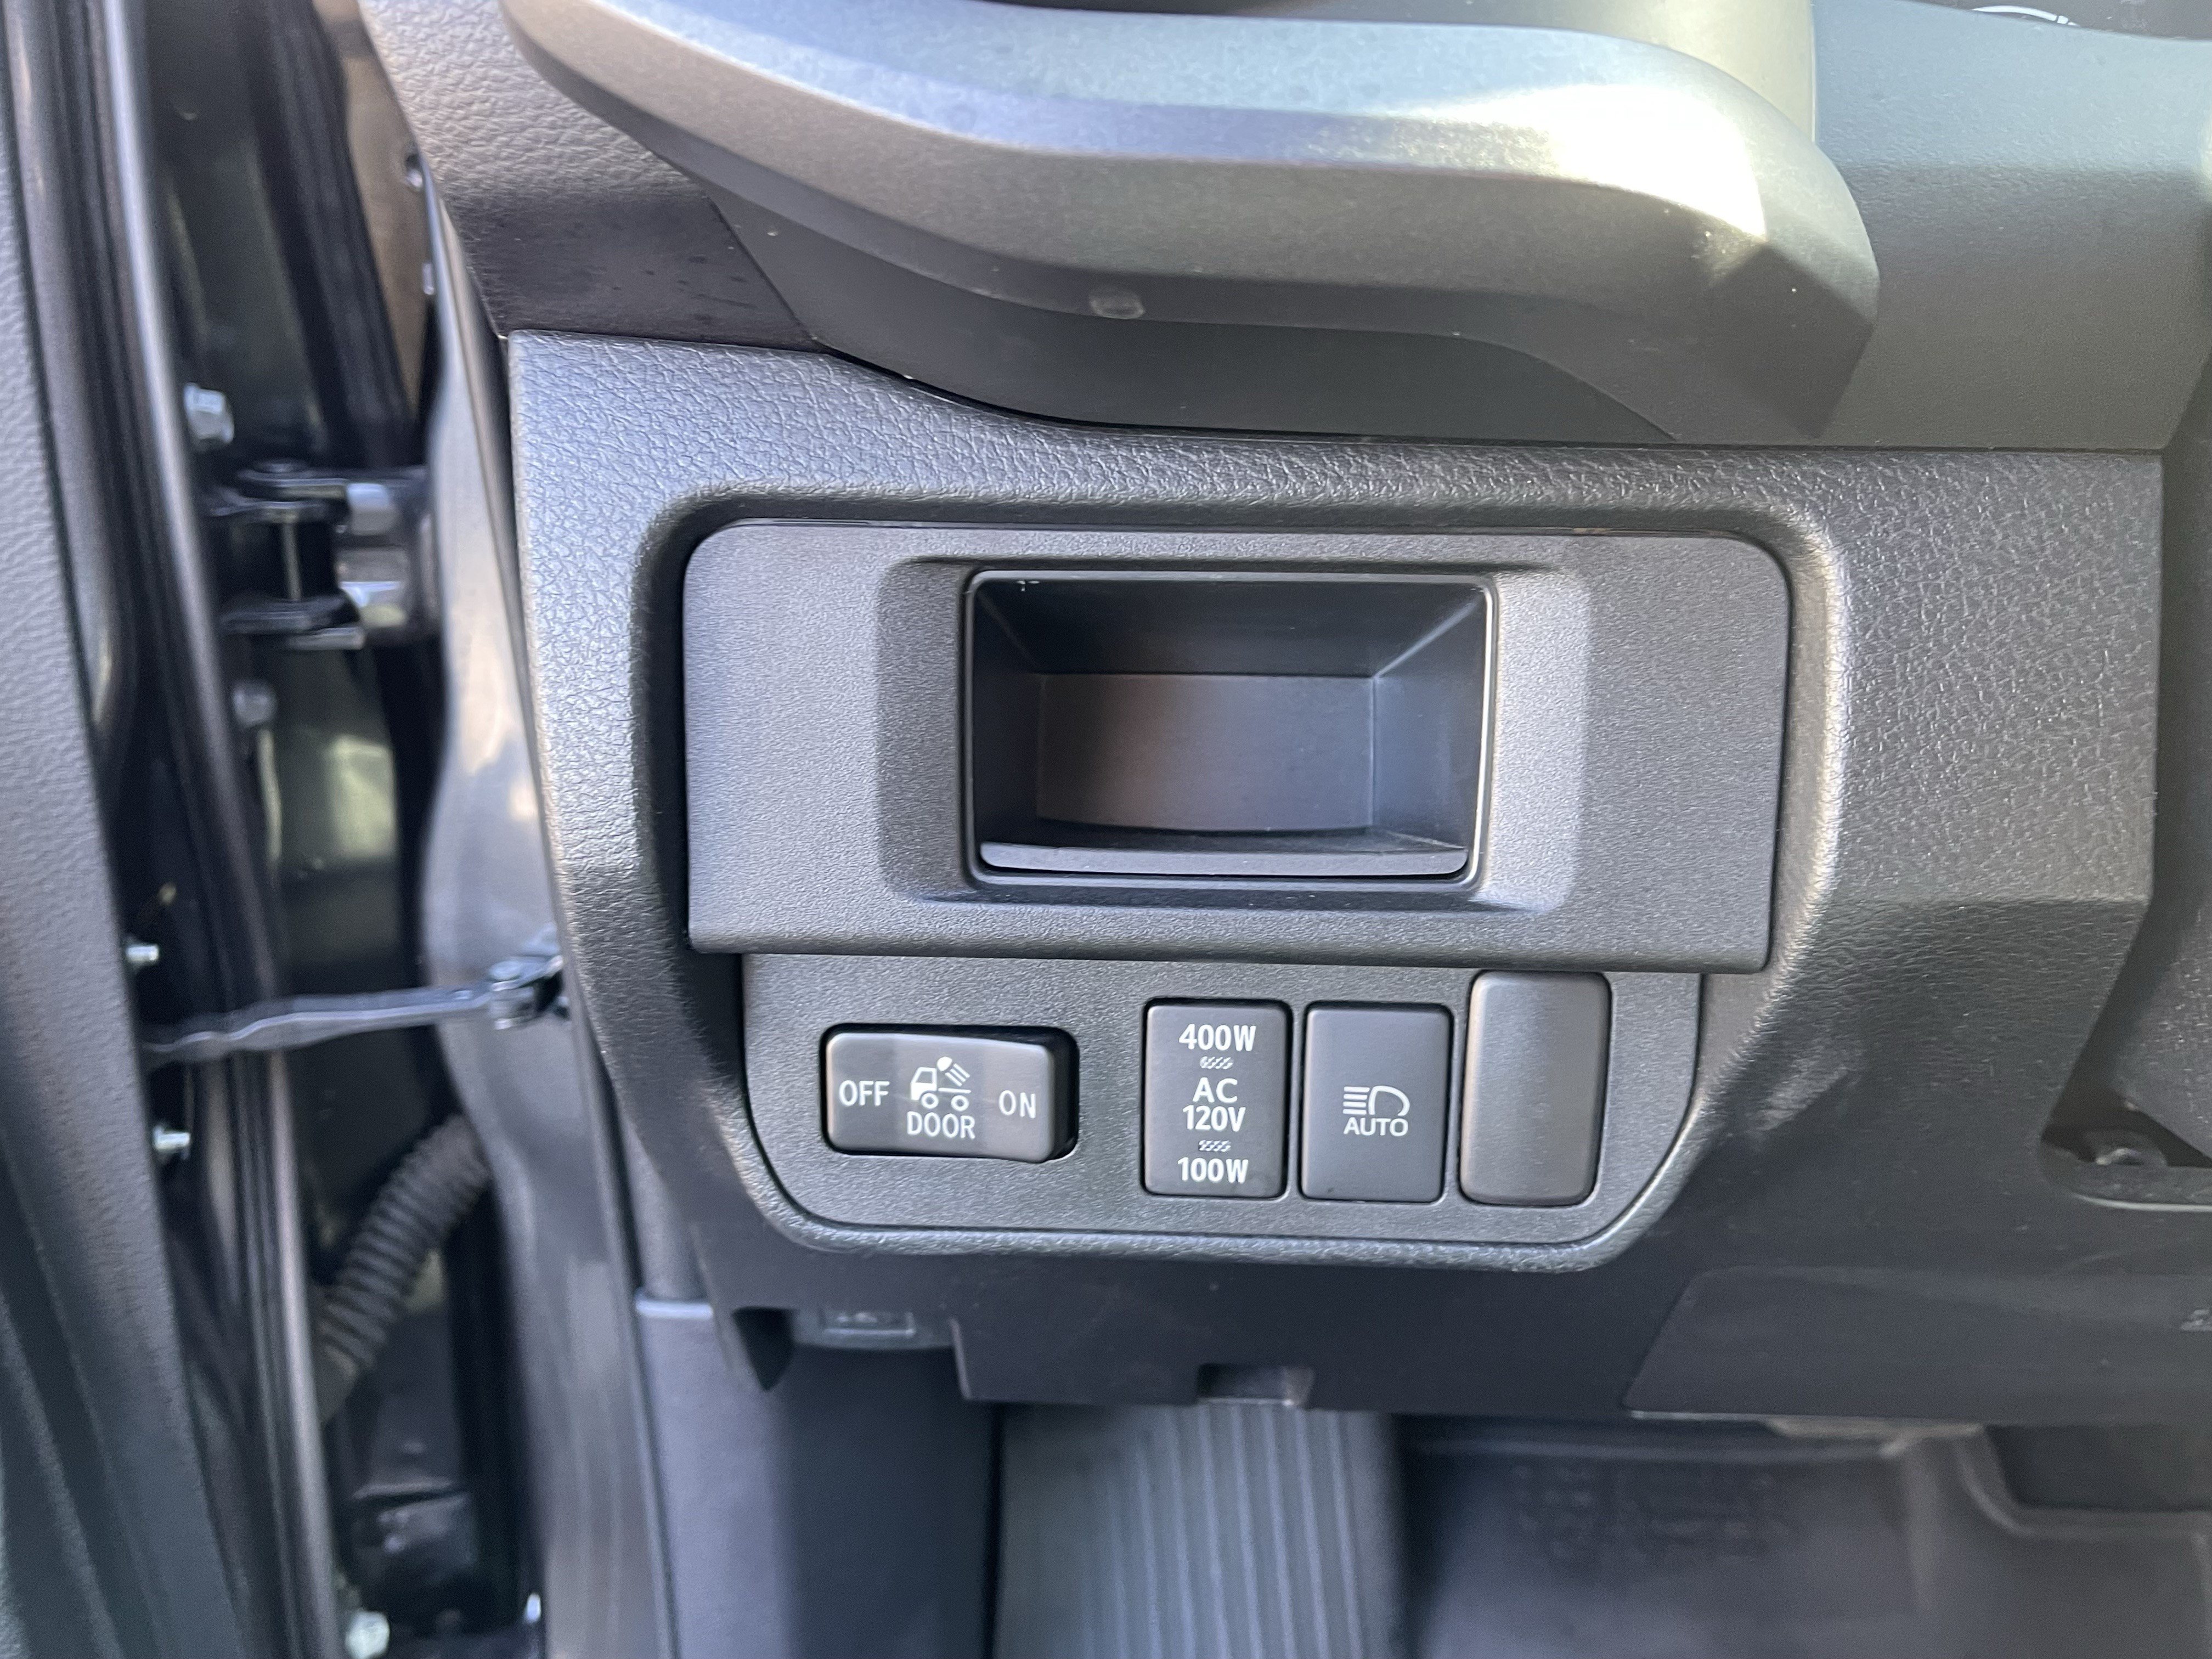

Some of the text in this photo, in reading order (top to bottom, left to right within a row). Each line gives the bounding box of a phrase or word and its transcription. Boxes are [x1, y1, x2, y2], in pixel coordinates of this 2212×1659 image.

[1178, 1023, 1256, 1052] 400W
[838, 1080, 890, 1107] OFF
[1192, 1077, 1238, 1103] AC
[998, 1090, 1036, 1119] ON
[1182, 1104, 1246, 1132] 120V
[906, 1111, 975, 1139] DOOR
[1343, 1118, 1409, 1137] AUTO
[1177, 1156, 1249, 1183] 100W
